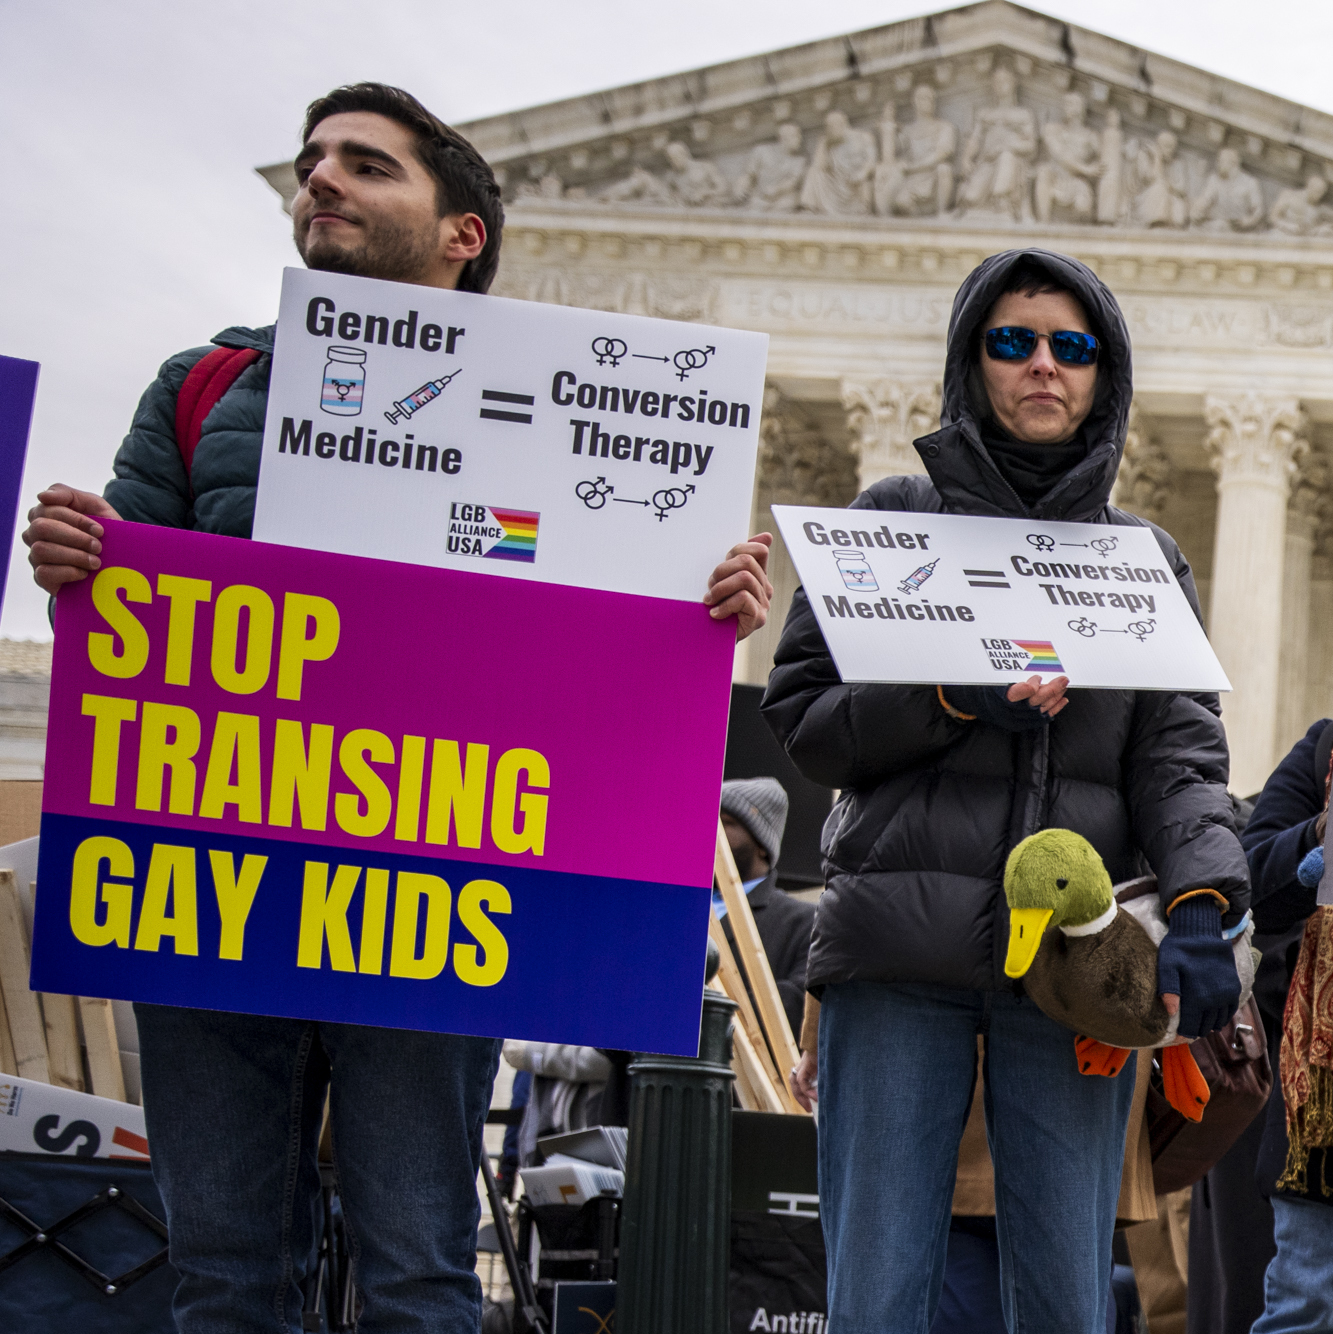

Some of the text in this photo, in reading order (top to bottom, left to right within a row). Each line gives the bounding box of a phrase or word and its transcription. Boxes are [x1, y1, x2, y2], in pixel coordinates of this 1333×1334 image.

[305, 297, 466, 355] Gender
[550, 371, 750, 428] Conversion
[278, 417, 463, 475] Medicine
[569, 419, 714, 475] Therapy
[450, 502, 486, 523] LGB
[447, 535, 483, 556] USA
[450, 522, 502, 540] ALLIANCE
[803, 521, 930, 551] Gender
[1010, 555, 1170, 584] Conversion
[822, 595, 975, 622] Medicine
[1039, 583, 1156, 614] Therapy
[87, 566, 341, 701] STOP
[981, 638, 1012, 651] LGB
[988, 650, 1031, 660] ALLIANCE
[990, 658, 1023, 671] USA
[81, 692, 551, 857] TRANSING
[69, 835, 513, 987] GAY KIDS
